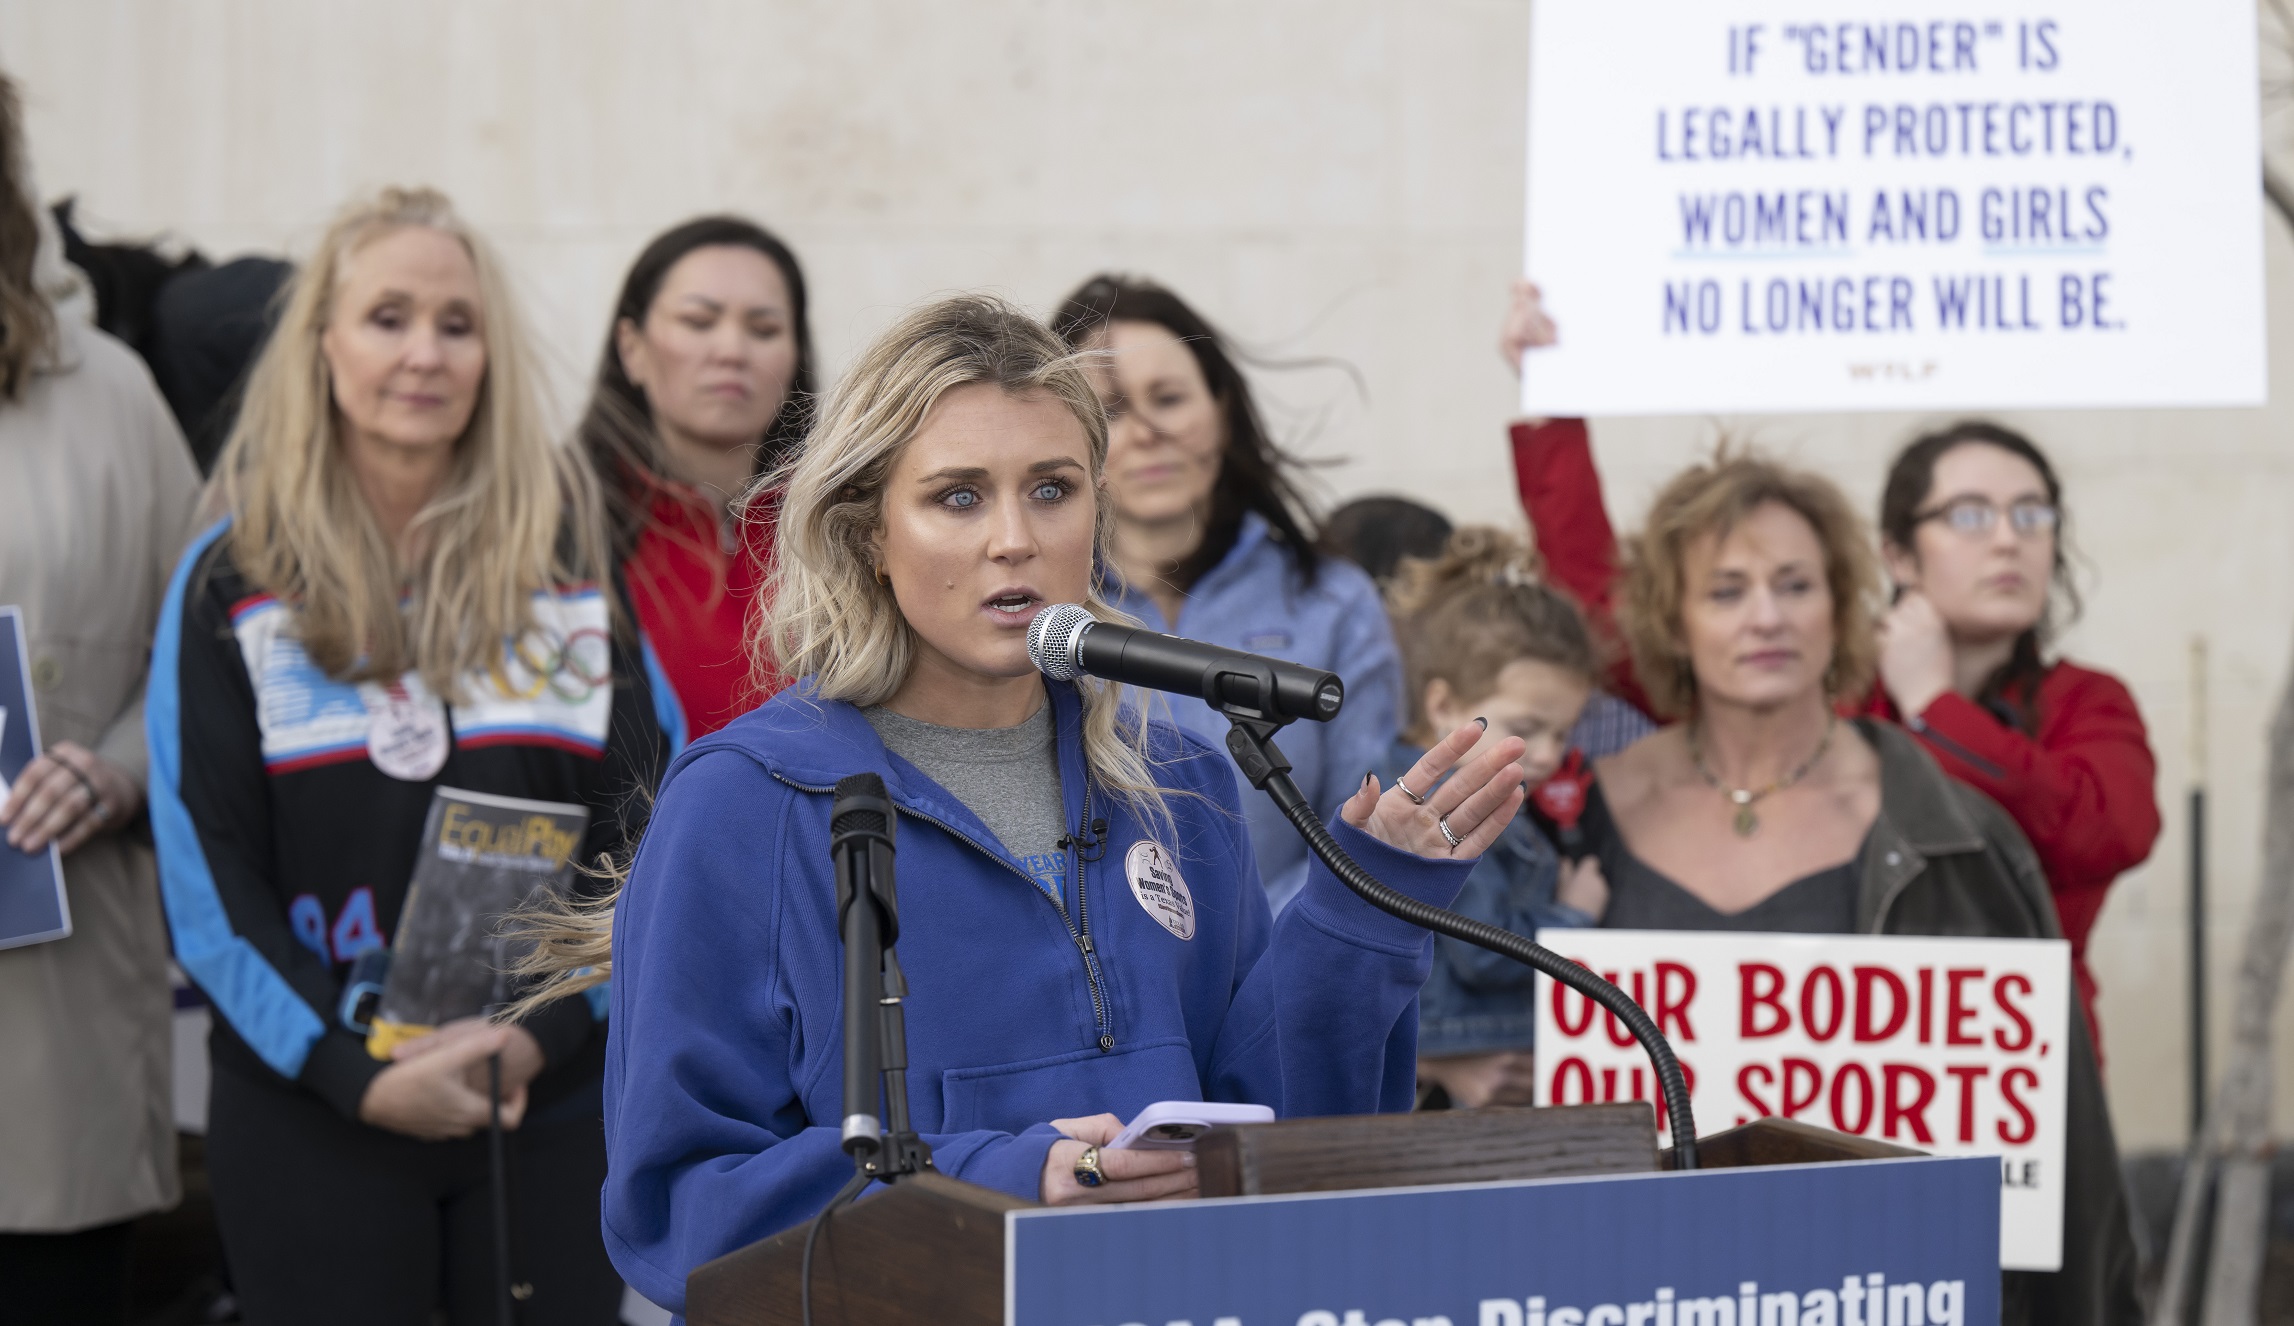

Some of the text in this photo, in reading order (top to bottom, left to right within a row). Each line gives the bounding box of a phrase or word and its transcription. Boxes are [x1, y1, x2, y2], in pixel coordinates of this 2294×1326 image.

[1727, 19, 2061, 75] IF "GENDER" IS
[1656, 100, 2132, 162] LEGALLY PROTECTED,
[1678, 185, 2111, 246] WOMEN AND GIRLS
[1663, 272, 2126, 336] NO LONGER WILL BE.
[1148, 866, 1174, 887] Saving
[1552, 959, 2050, 1058] OUR BODIES,
[1737, 1056, 2039, 1146] SPORTS
